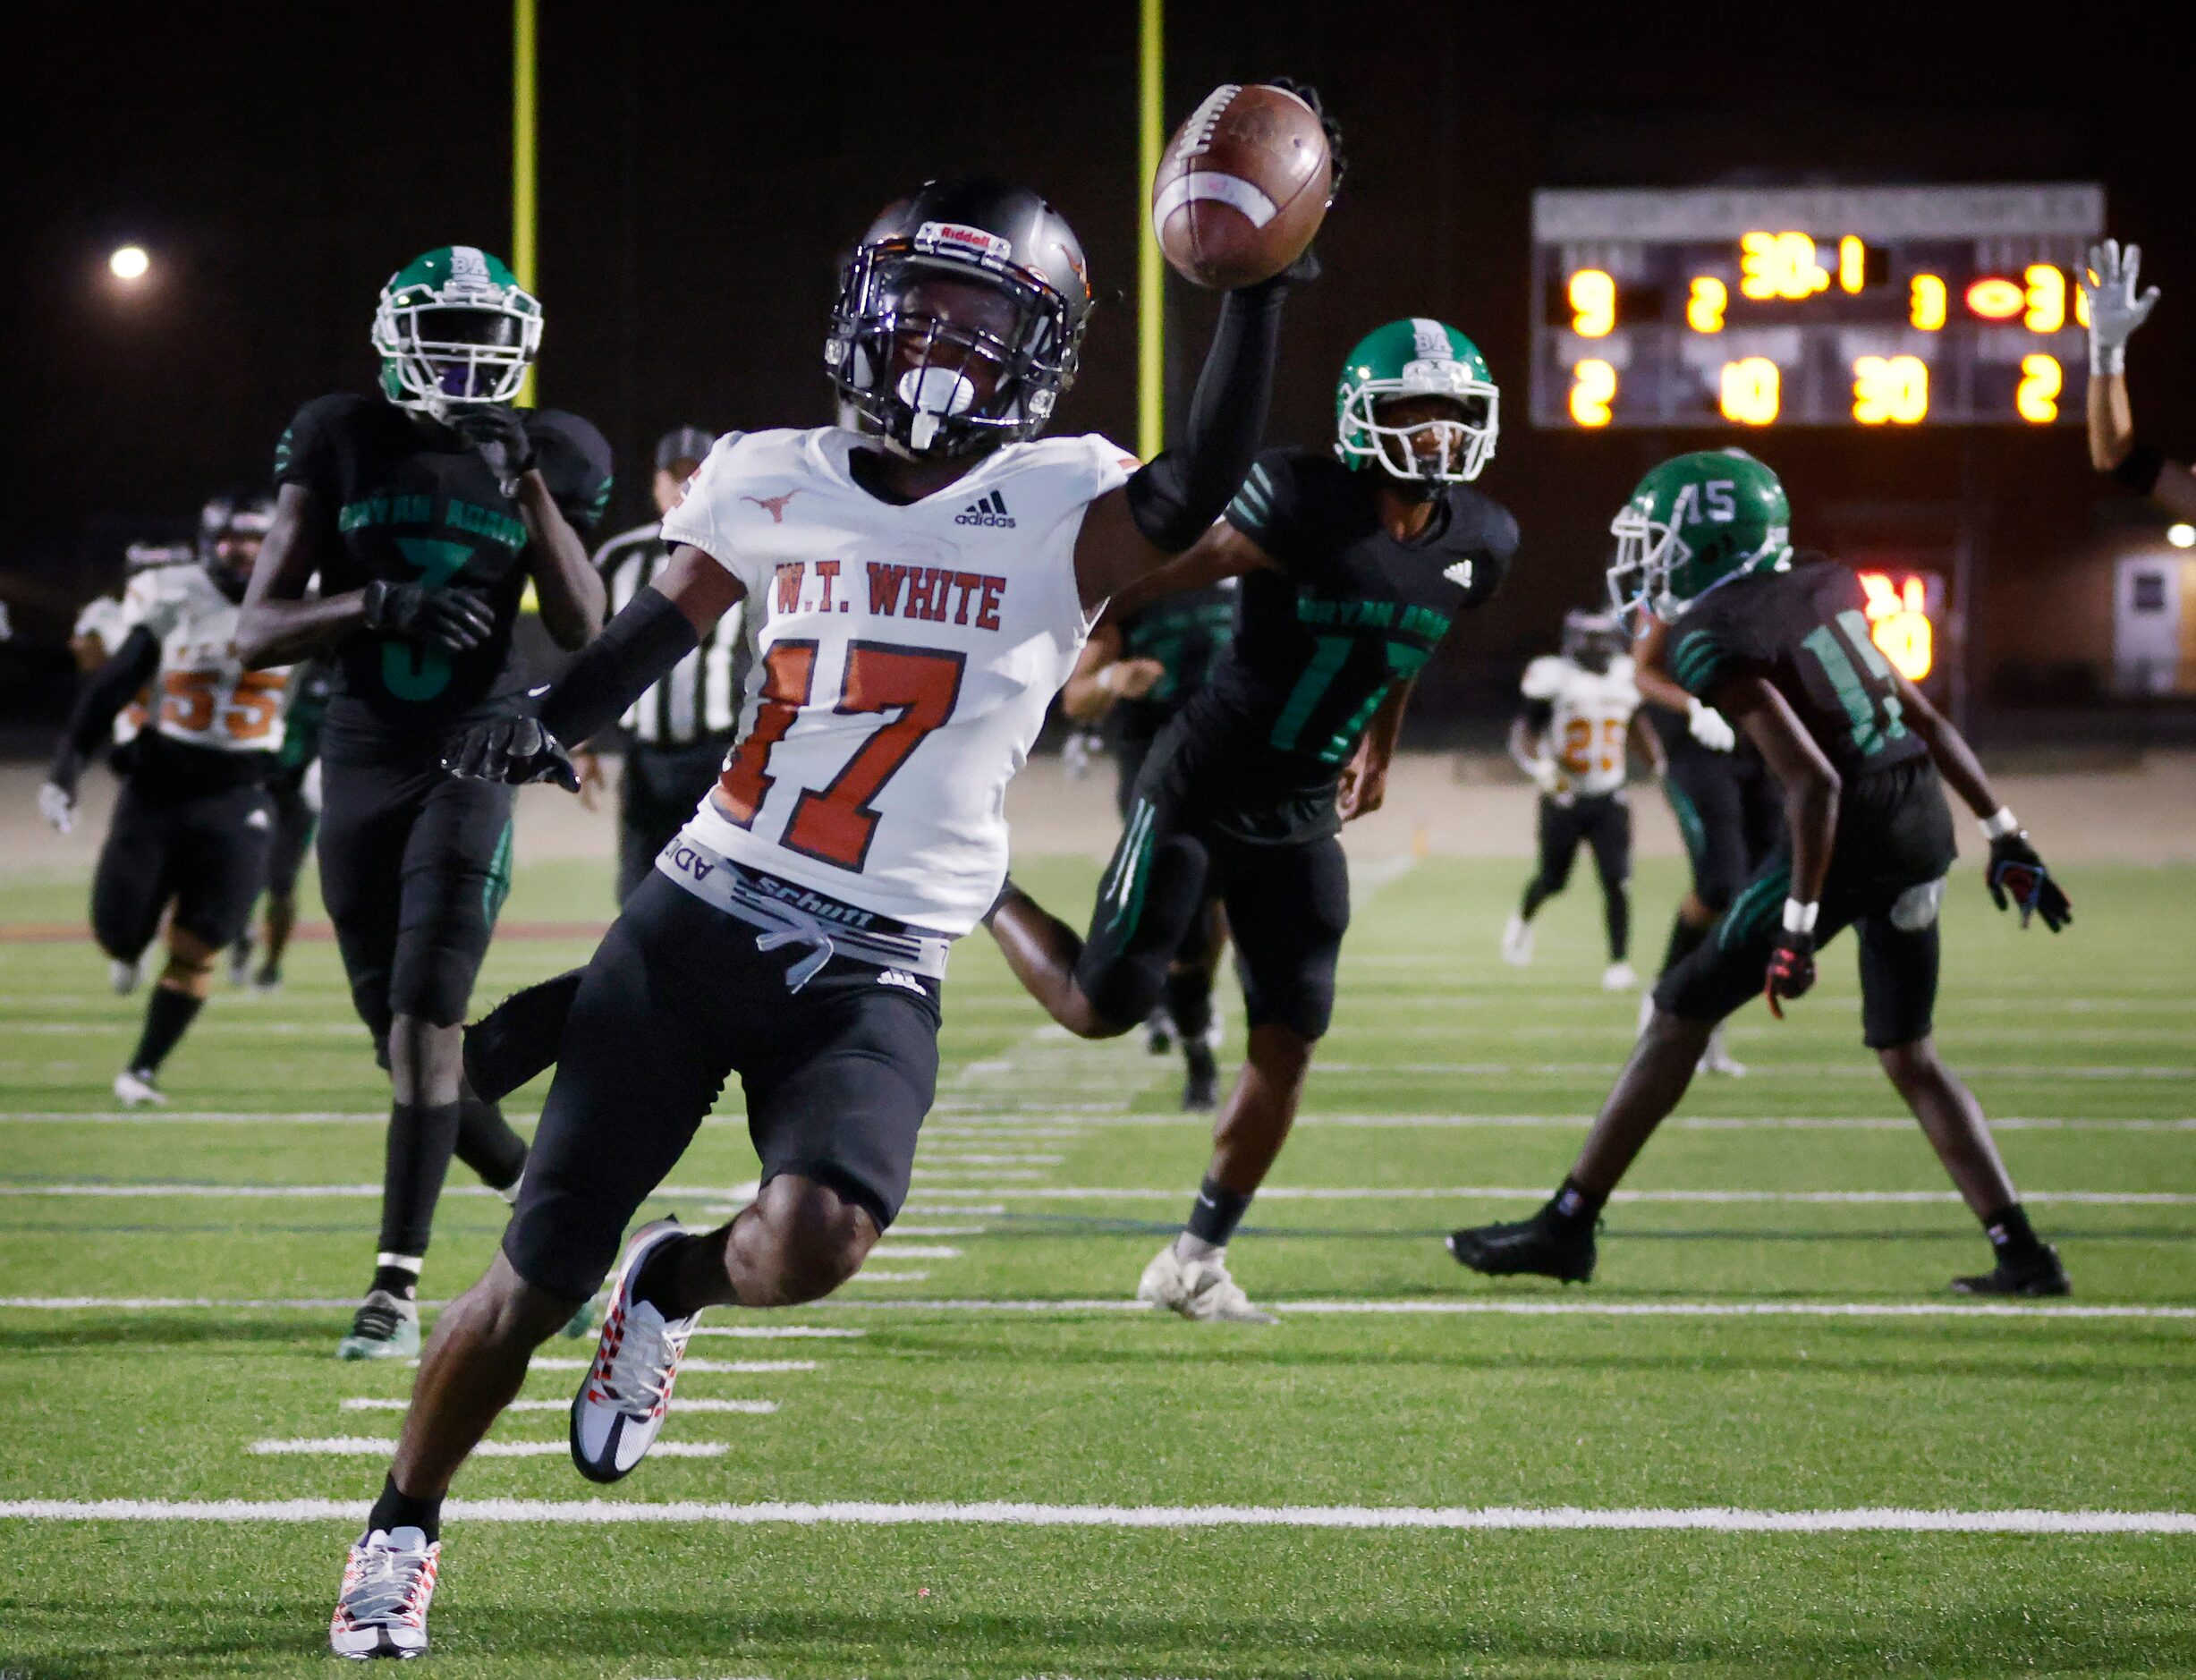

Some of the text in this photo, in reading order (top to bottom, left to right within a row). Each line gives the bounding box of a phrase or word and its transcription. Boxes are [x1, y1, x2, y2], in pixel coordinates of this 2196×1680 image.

[450, 256, 489, 276] BA
[942, 226, 990, 247] Riddell
[1568, 269, 1615, 338] 9
[1687, 276, 1727, 334] 2
[1910, 274, 1947, 331] 3
[1414, 332, 1453, 352] BA
[1569, 359, 1615, 428] 2
[1853, 355, 1929, 426] 30
[2015, 354, 2062, 423] 2
[954, 511, 1016, 530] adidas
[1683, 479, 1735, 524] 15
[776, 560, 1007, 632] W.T. WHITE
[161, 669, 287, 740] 55
[1270, 634, 1431, 764] 17
[710, 639, 968, 874] 17
